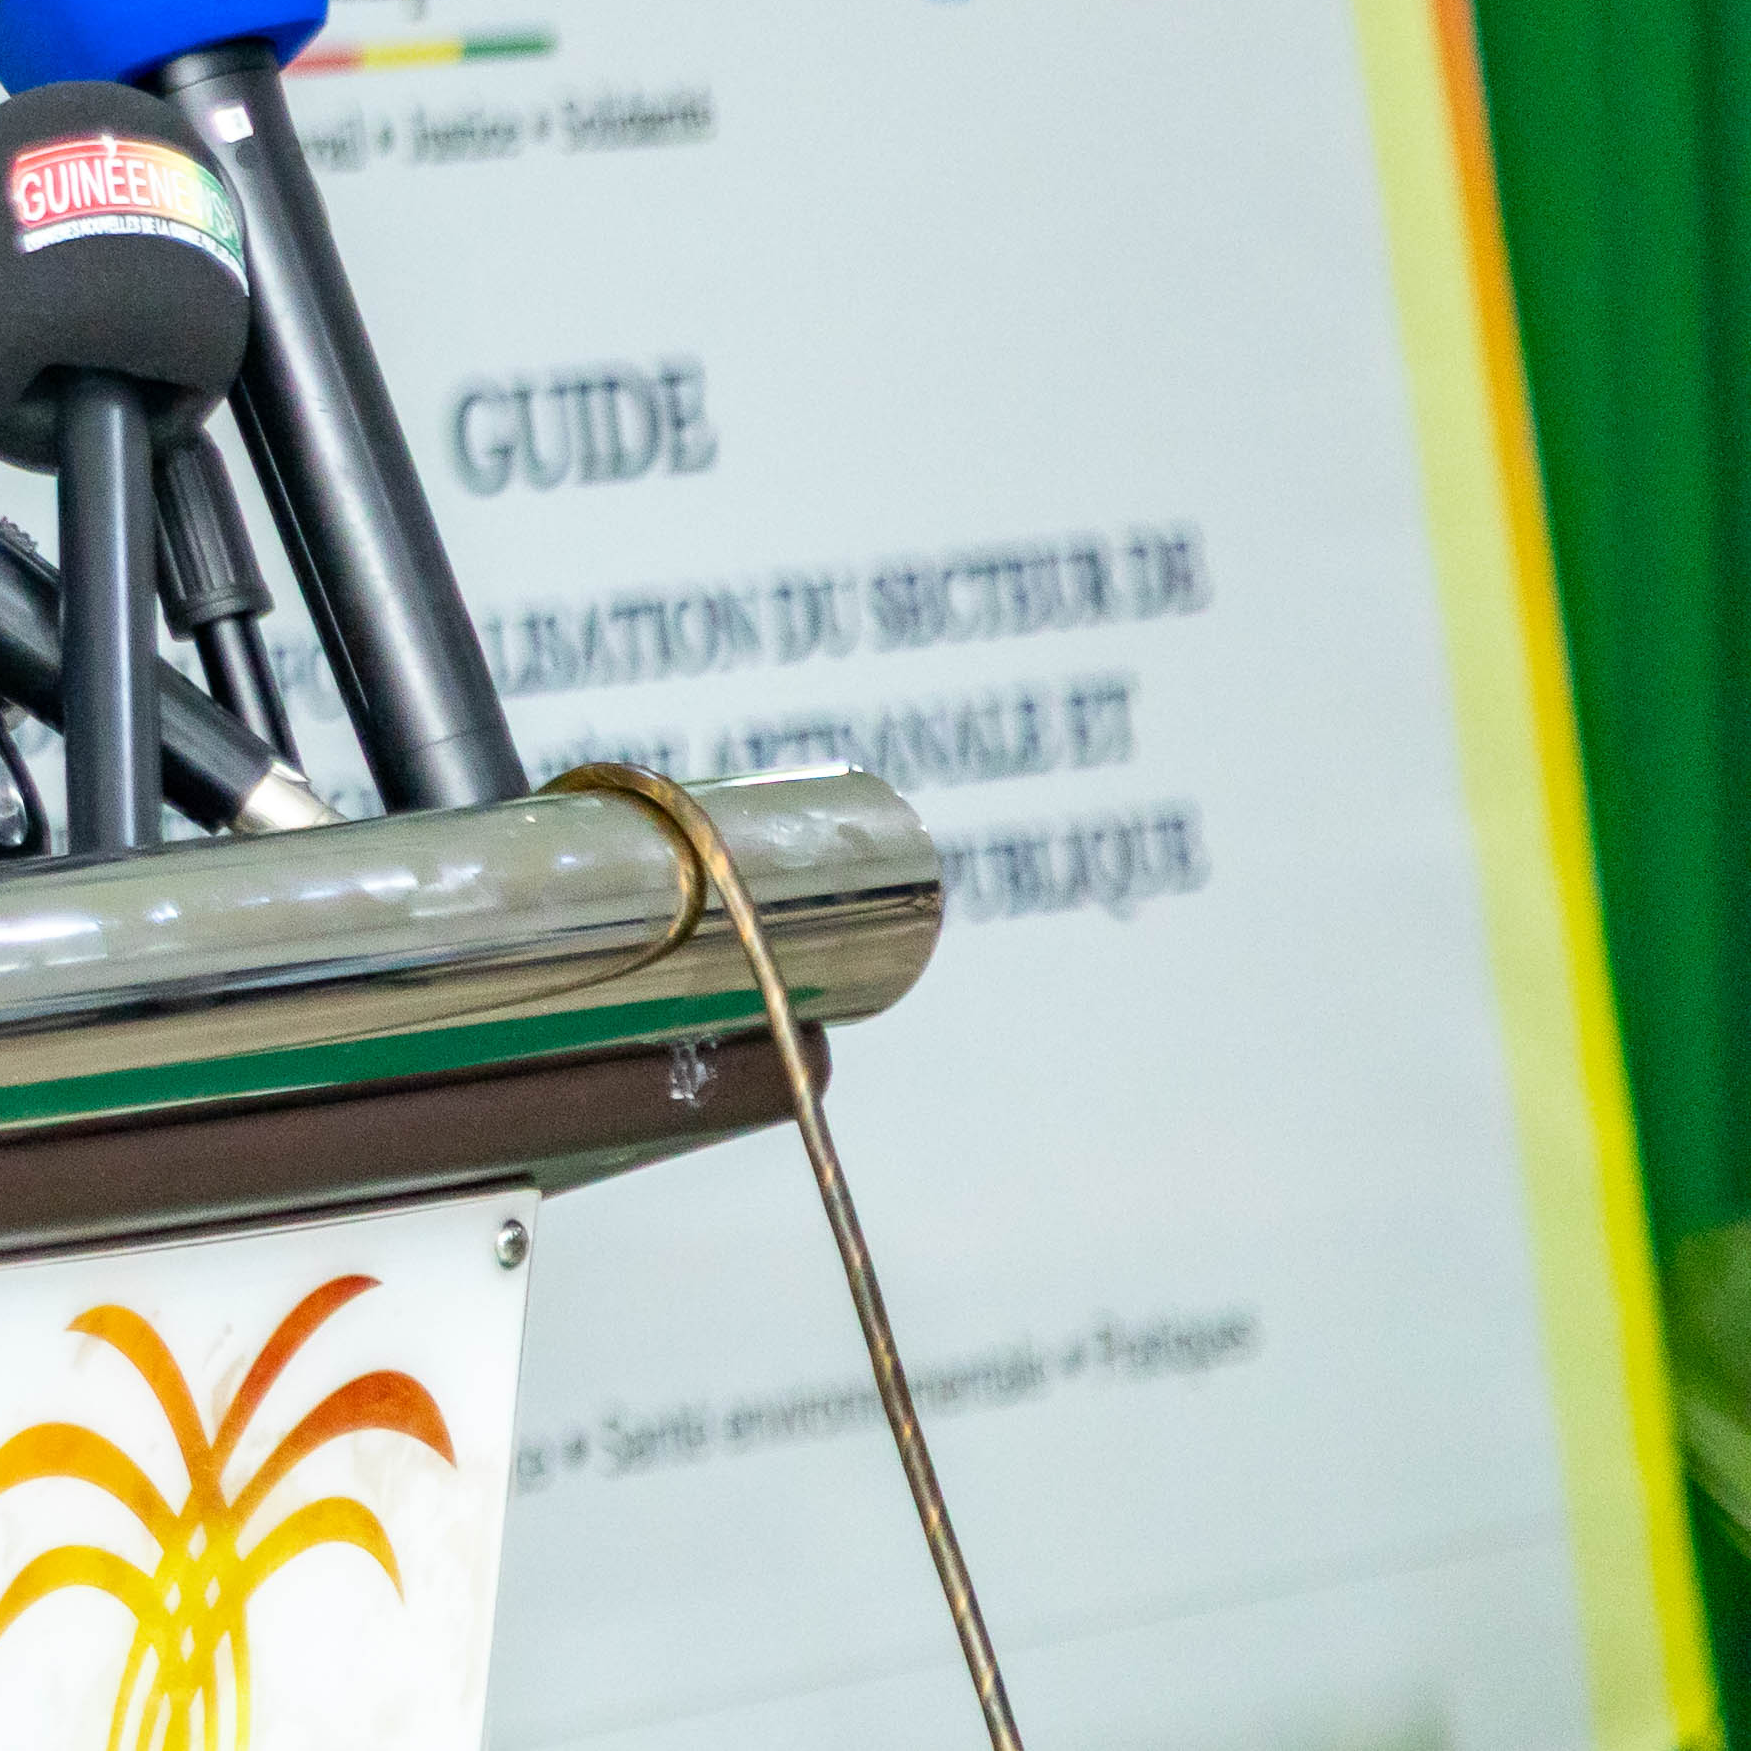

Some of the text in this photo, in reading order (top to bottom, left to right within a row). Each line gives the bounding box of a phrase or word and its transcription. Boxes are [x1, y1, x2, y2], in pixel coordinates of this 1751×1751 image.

[450, 354, 720, 499] GUIDE
[770, 569, 858, 666] DU
[866, 537, 1112, 654] SECTEUR
[1123, 517, 1214, 624] DE
[1064, 670, 1142, 775] ET
